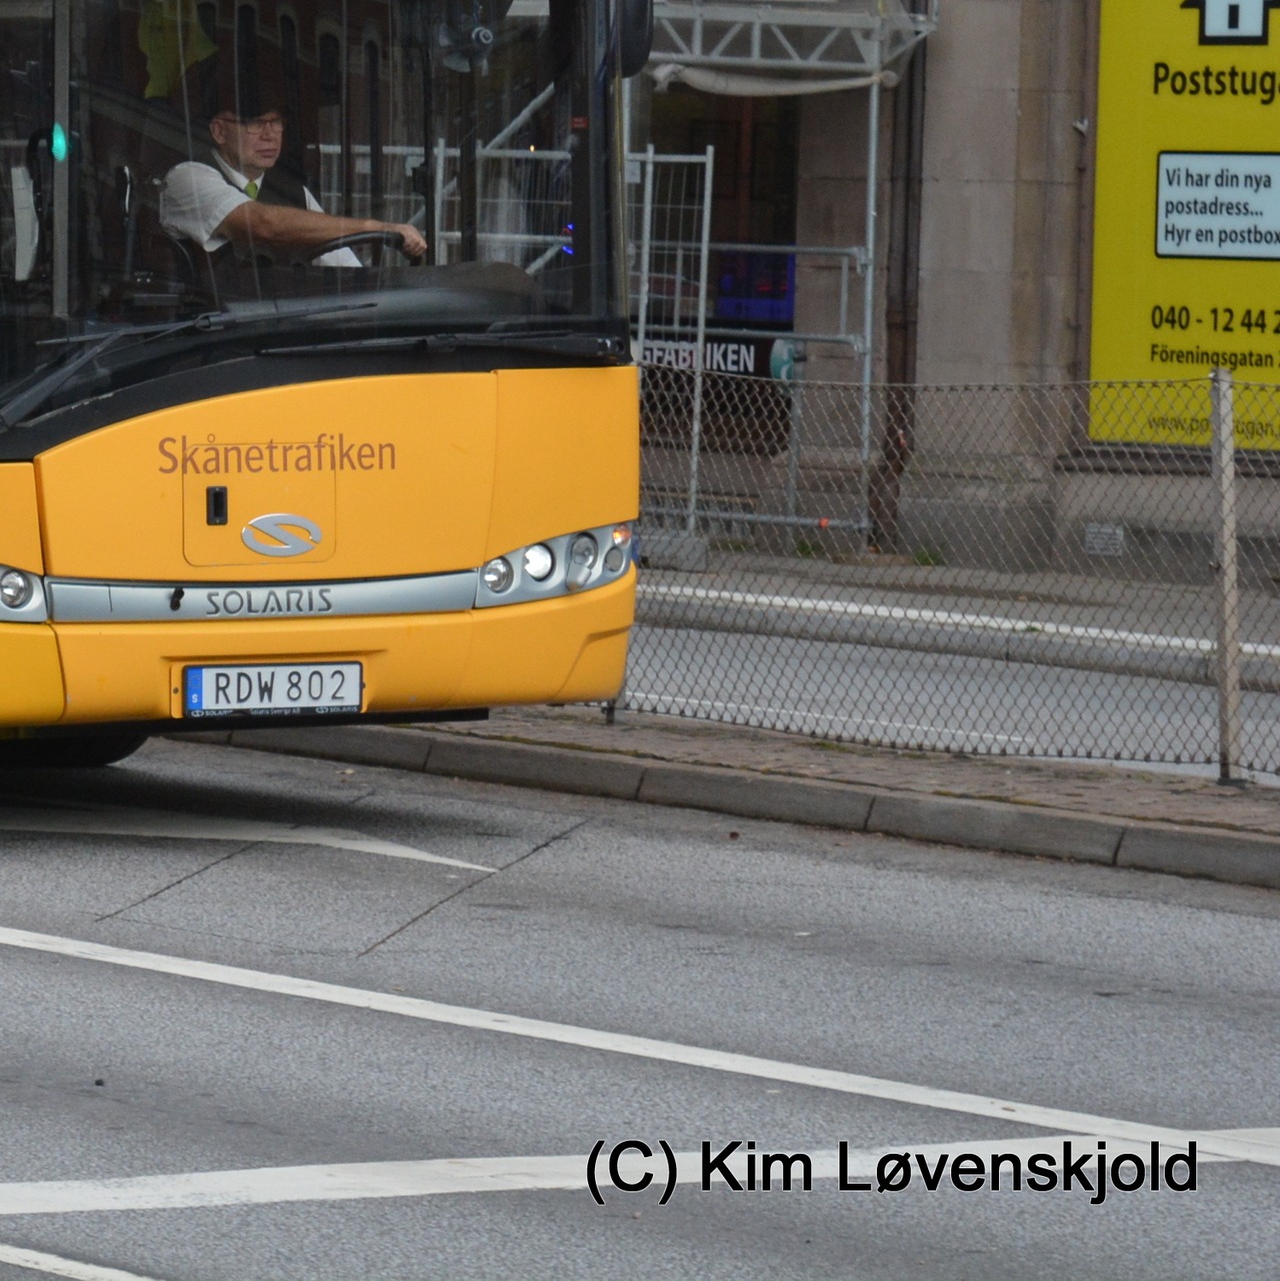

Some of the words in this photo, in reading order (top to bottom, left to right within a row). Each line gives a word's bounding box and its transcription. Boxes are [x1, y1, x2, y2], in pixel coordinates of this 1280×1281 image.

[1153, 62, 1280, 105] Poststug
[1166, 168, 1181, 187] Vi
[1185, 168, 1211, 188] har
[1214, 169, 1239, 189] din
[1244, 174, 1272, 193] nya
[1164, 196, 1264, 219] postadress...
[1164, 223, 1191, 246] Hyr
[1195, 229, 1214, 243] en
[1218, 225, 1280, 248] postbox
[1151, 305, 1191, 330] 040
[1211, 307, 1235, 333] 12
[1241, 309, 1267, 333] 44
[1150, 343, 1274, 371] Föreningsgatan
[158, 432, 397, 477] Skånetrafiken
[206, 587, 334, 617] SOLARIS
[191, 693, 199, 704] S
[214, 670, 276, 705] RDW
[286, 669, 346, 702] 802
